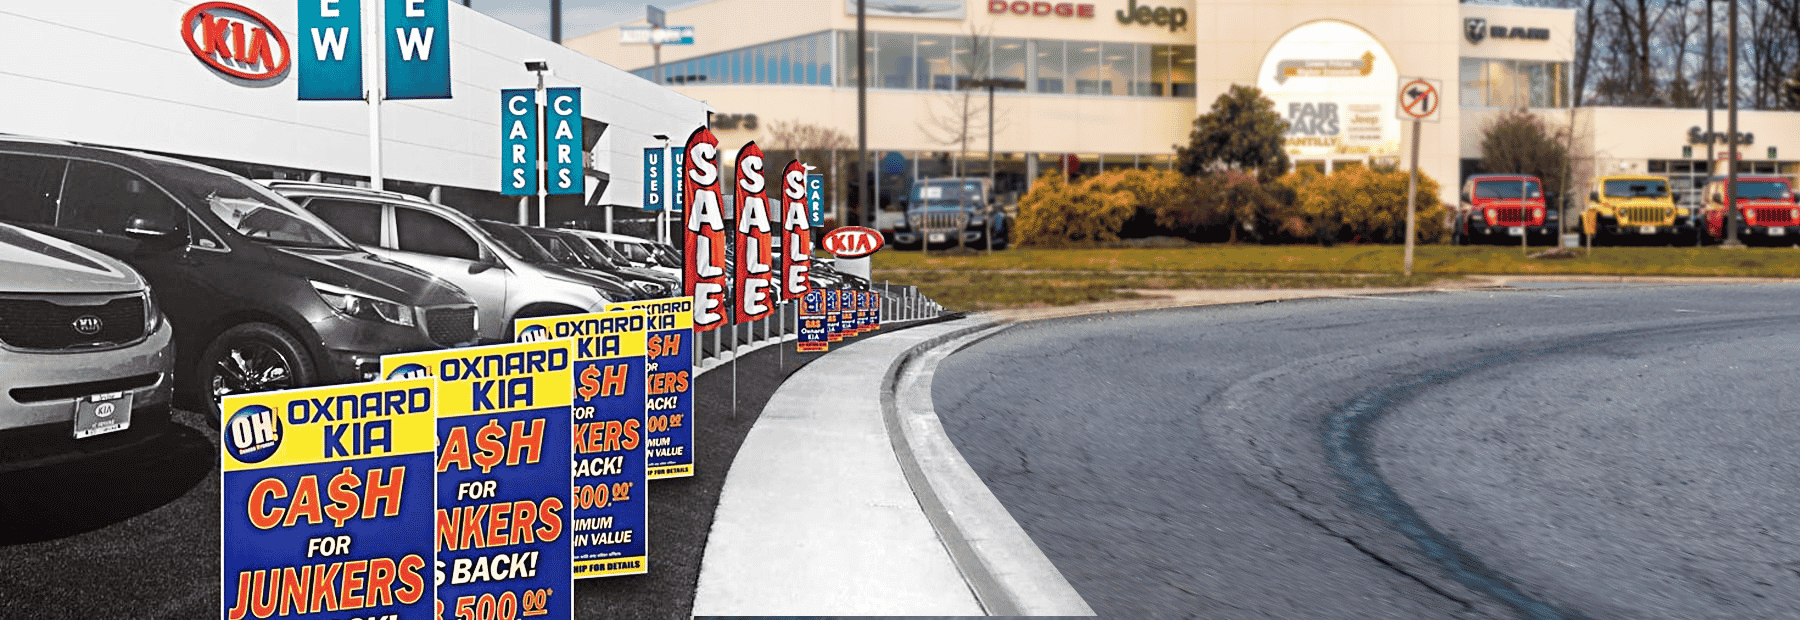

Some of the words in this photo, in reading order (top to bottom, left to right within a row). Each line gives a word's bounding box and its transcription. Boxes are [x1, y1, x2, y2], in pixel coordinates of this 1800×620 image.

[987, 0, 1095, 19] DODGE
[1116, 0, 1188, 32] Jeep
[199, 10, 276, 71] KIA
[1489, 26, 1550, 41] RAM
[1288, 102, 1338, 120] FAIR
[1284, 117, 1340, 136] AKS
[508, 95, 528, 189] CARS
[554, 95, 573, 189] CARS
[1285, 137, 1338, 147] ANTILLY
[649, 153, 659, 204] USED
[811, 179, 820, 222] CARS
[688, 142, 725, 325] SALE
[739, 155, 770, 316] SALE
[784, 170, 810, 294] SALE
[831, 233, 872, 252] KIA
[555, 315, 644, 338] OXNARD
[647, 314, 675, 330] KIA
[578, 335, 619, 358] KIA
[647, 334, 681, 360] $H
[440, 347, 568, 382] OXNARD
[647, 362, 659, 371] OR
[472, 376, 534, 411] KIA
[576, 364, 630, 402] $H
[97, 405, 112, 415] KIA
[287, 387, 431, 425] OXNARD
[574, 406, 597, 420] OR
[647, 396, 678, 411] ACK!
[231, 407, 279, 449] OH!
[324, 419, 392, 459] KIA
[437, 419, 546, 474] A$H
[655, 446, 683, 457] VALUE
[248, 466, 406, 530] CA$H
[458, 480, 497, 501] FOR
[437, 497, 564, 552] NKERS
[574, 516, 613, 531] IMUM
[307, 535, 351, 558] FOR
[574, 534, 589, 547] IN
[591, 530, 633, 546] VALUE
[451, 551, 539, 585] BACK!
[589, 563, 605, 572] FOR
[607, 560, 640, 570] DETAILS
[229, 554, 426, 620] JUNKERS
